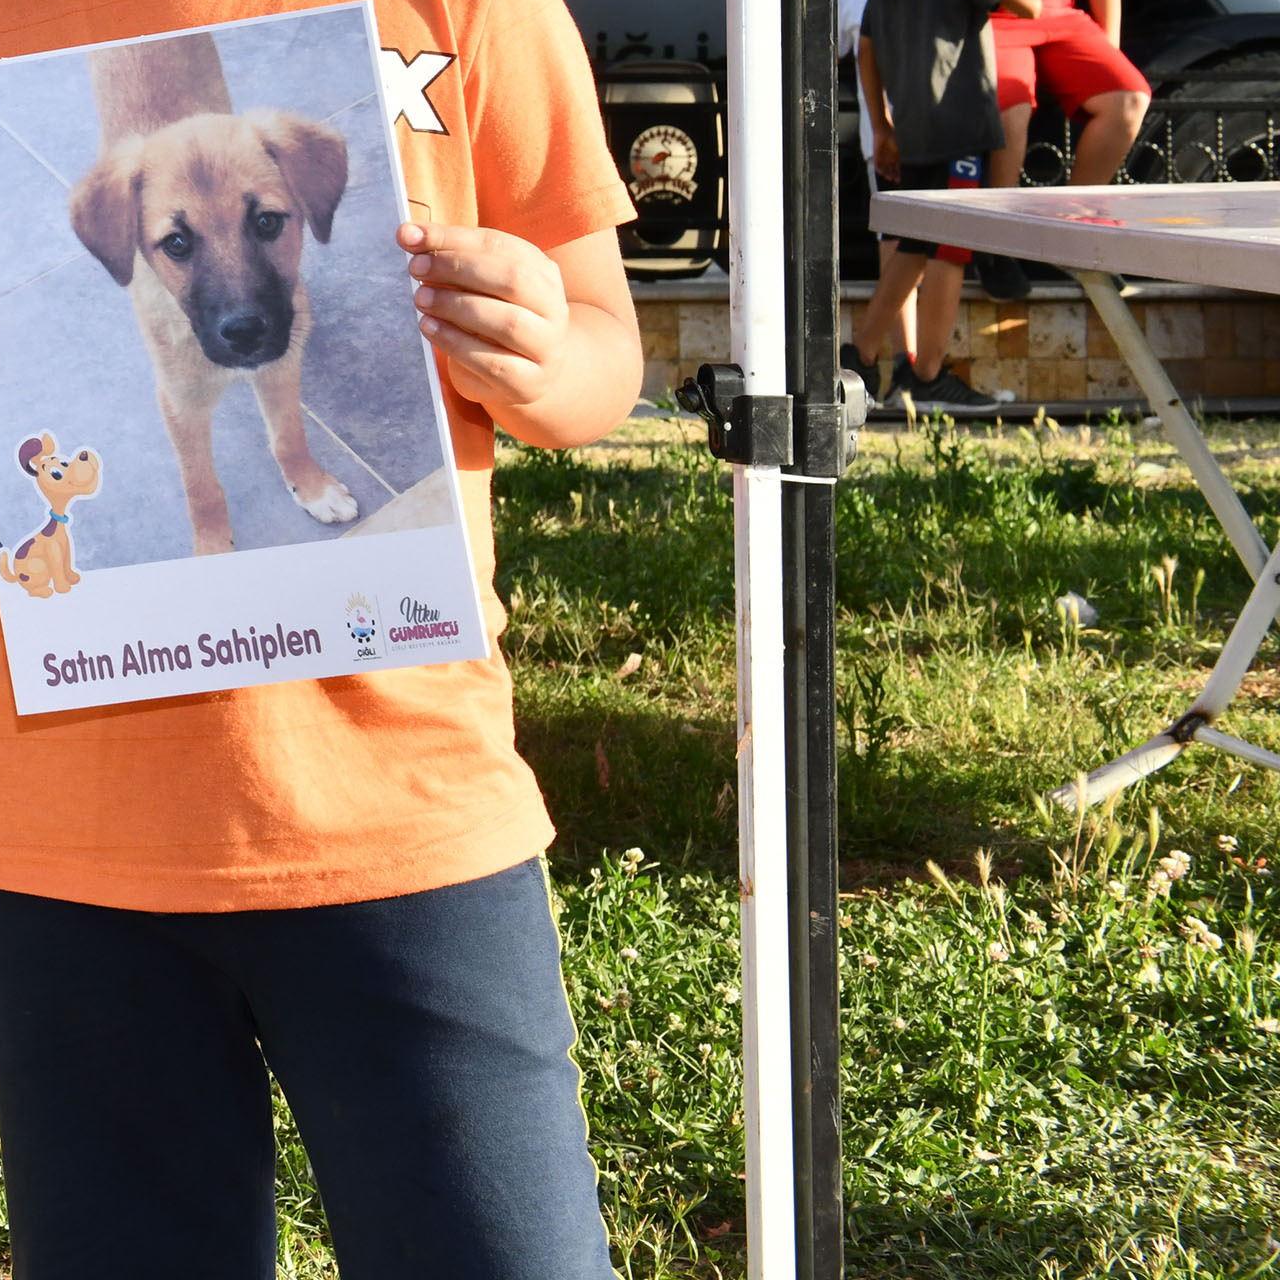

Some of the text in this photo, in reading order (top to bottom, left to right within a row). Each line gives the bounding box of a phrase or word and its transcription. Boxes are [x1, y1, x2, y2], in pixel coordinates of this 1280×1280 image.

[399, 596, 441, 625] Utku
[43, 623, 322, 687] Satın Alma Sahiplen
